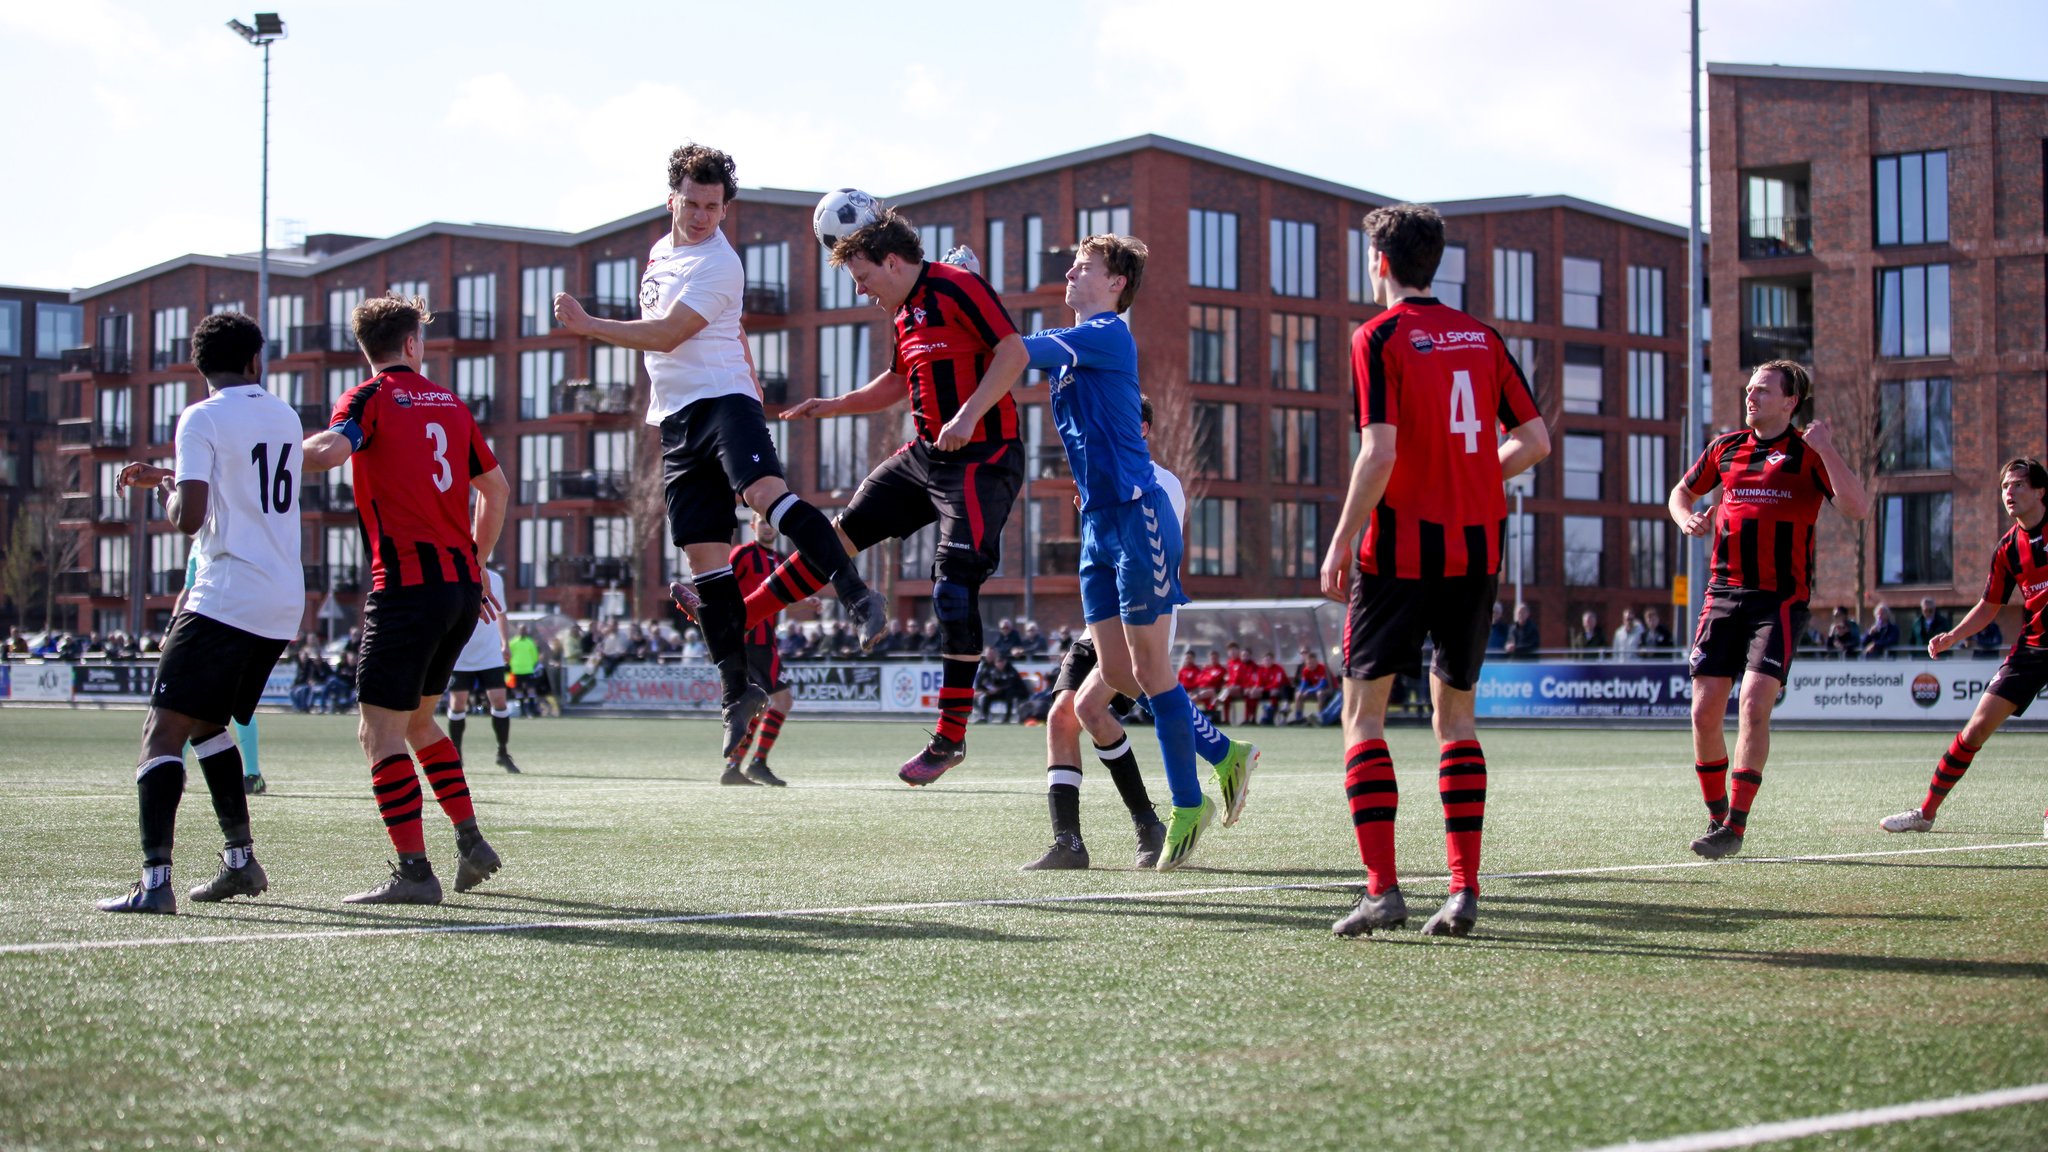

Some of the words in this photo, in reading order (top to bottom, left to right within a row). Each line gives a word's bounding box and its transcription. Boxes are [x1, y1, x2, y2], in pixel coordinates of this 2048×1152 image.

[1450, 370, 1481, 453] 4
[425, 423, 453, 493] 3
[252, 443, 292, 514] 16
[1732, 488, 1792, 499] TWINPACK.NL
[616, 667, 714, 679] UCADOORSBEDR
[786, 668, 830, 684] ANNY
[637, 681, 674, 700] VAN
[1540, 676, 1662, 704] Connectivity
[1794, 676, 1821, 691] your
[1825, 673, 1904, 690] professional
[1814, 692, 1884, 709] sportshop
[1914, 691, 1937, 699] 2000
[1651, 705, 1692, 717] SOLUTIO
